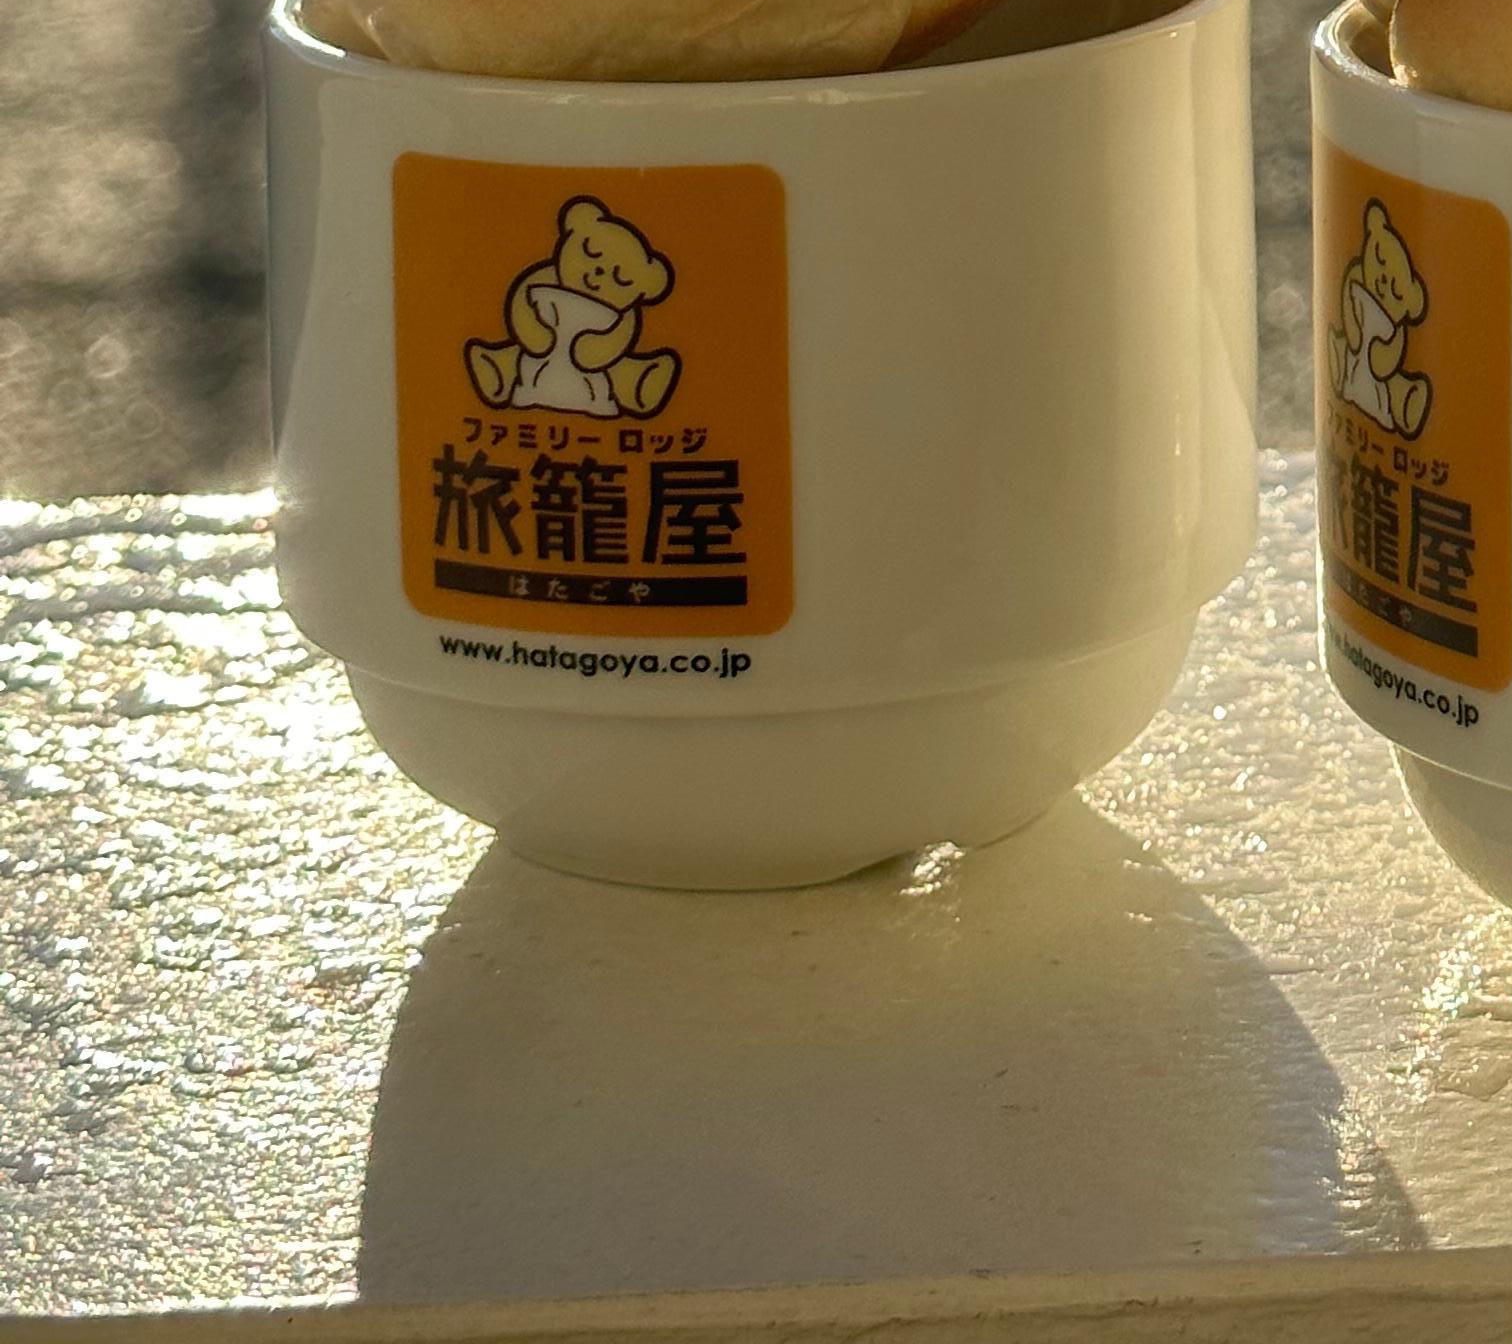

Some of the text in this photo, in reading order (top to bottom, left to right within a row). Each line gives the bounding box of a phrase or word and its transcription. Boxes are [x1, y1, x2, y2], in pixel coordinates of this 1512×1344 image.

[463, 417, 708, 454] ファミリー ロッジ
[1393, 445, 1450, 486] ロッジ
[433, 443, 748, 565] 旅籠屋
[508, 574, 651, 603] はたごや
[439, 635, 752, 679] www.hatagoya.co.jp
